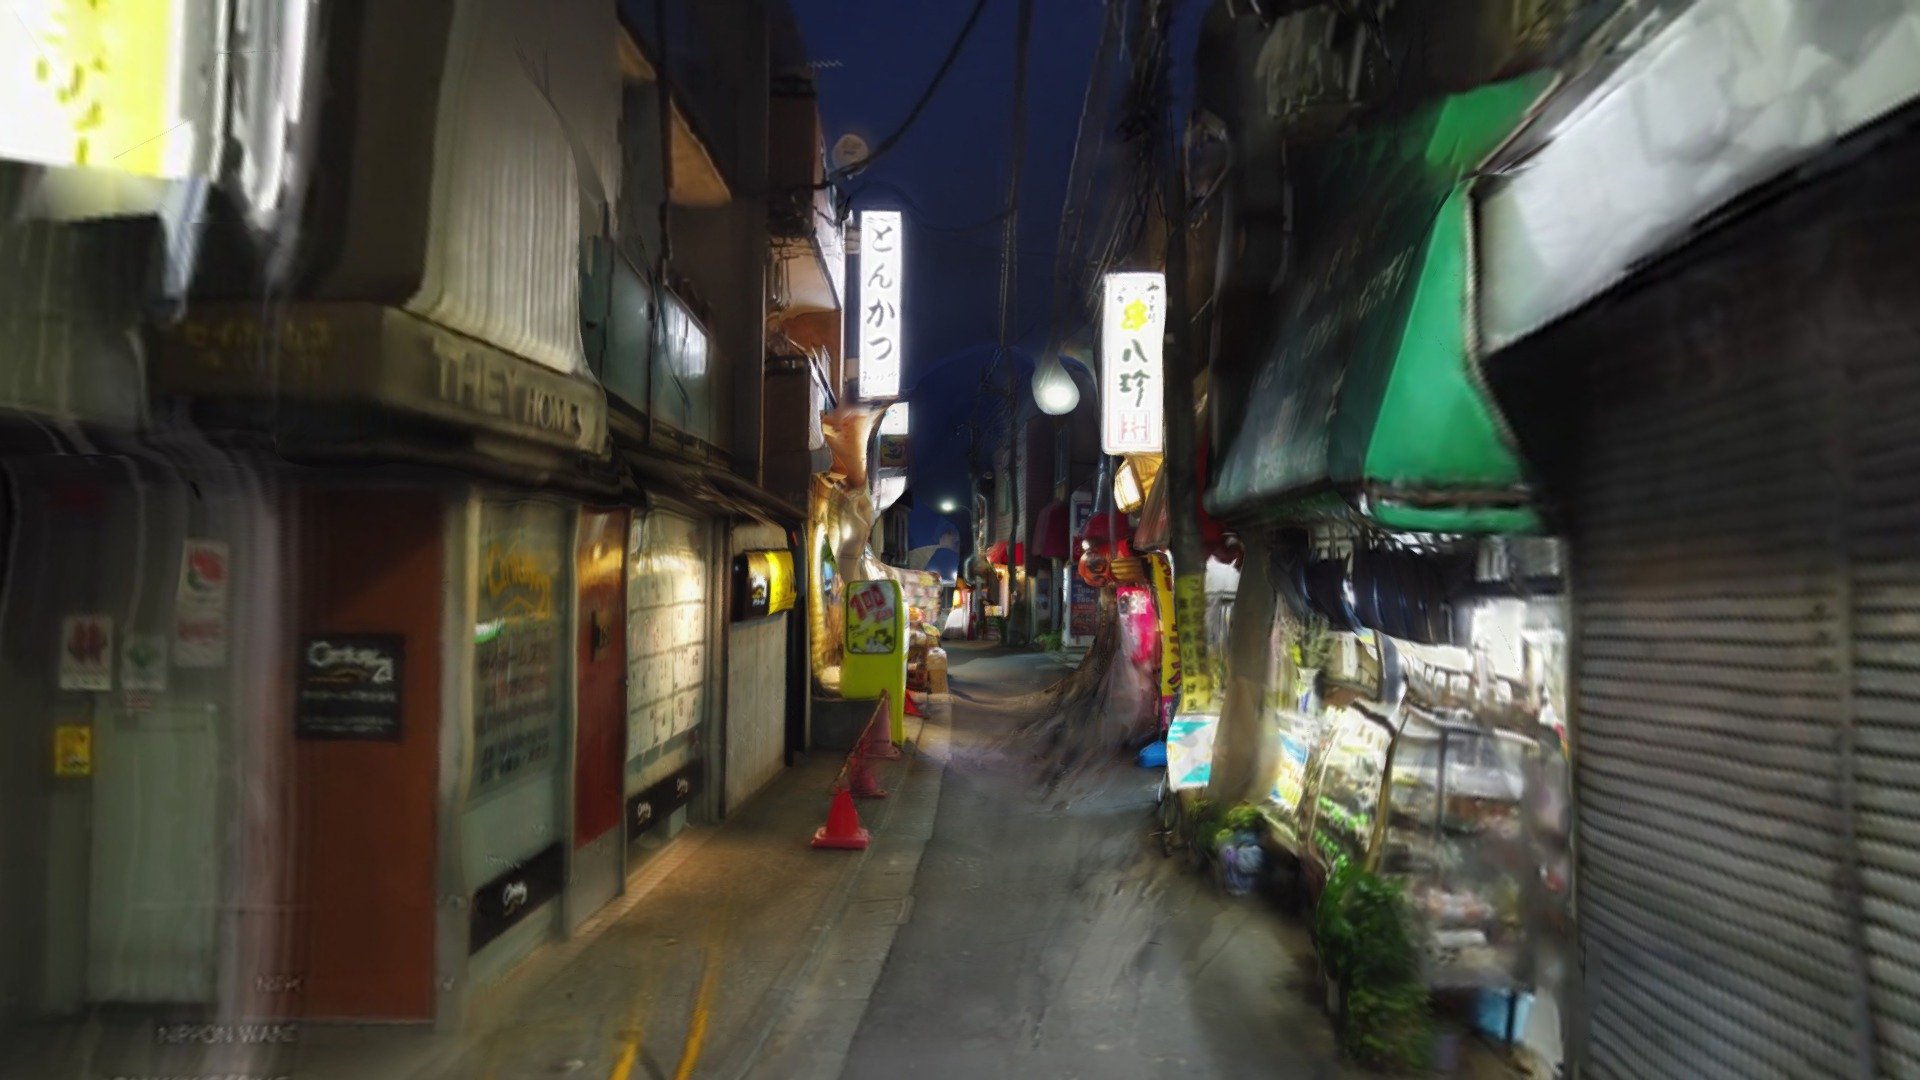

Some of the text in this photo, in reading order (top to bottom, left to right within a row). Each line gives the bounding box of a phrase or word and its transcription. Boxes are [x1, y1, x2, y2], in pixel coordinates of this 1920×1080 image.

[866, 225, 896, 361] とんかつ
[1119, 338, 1151, 408] 八珍
